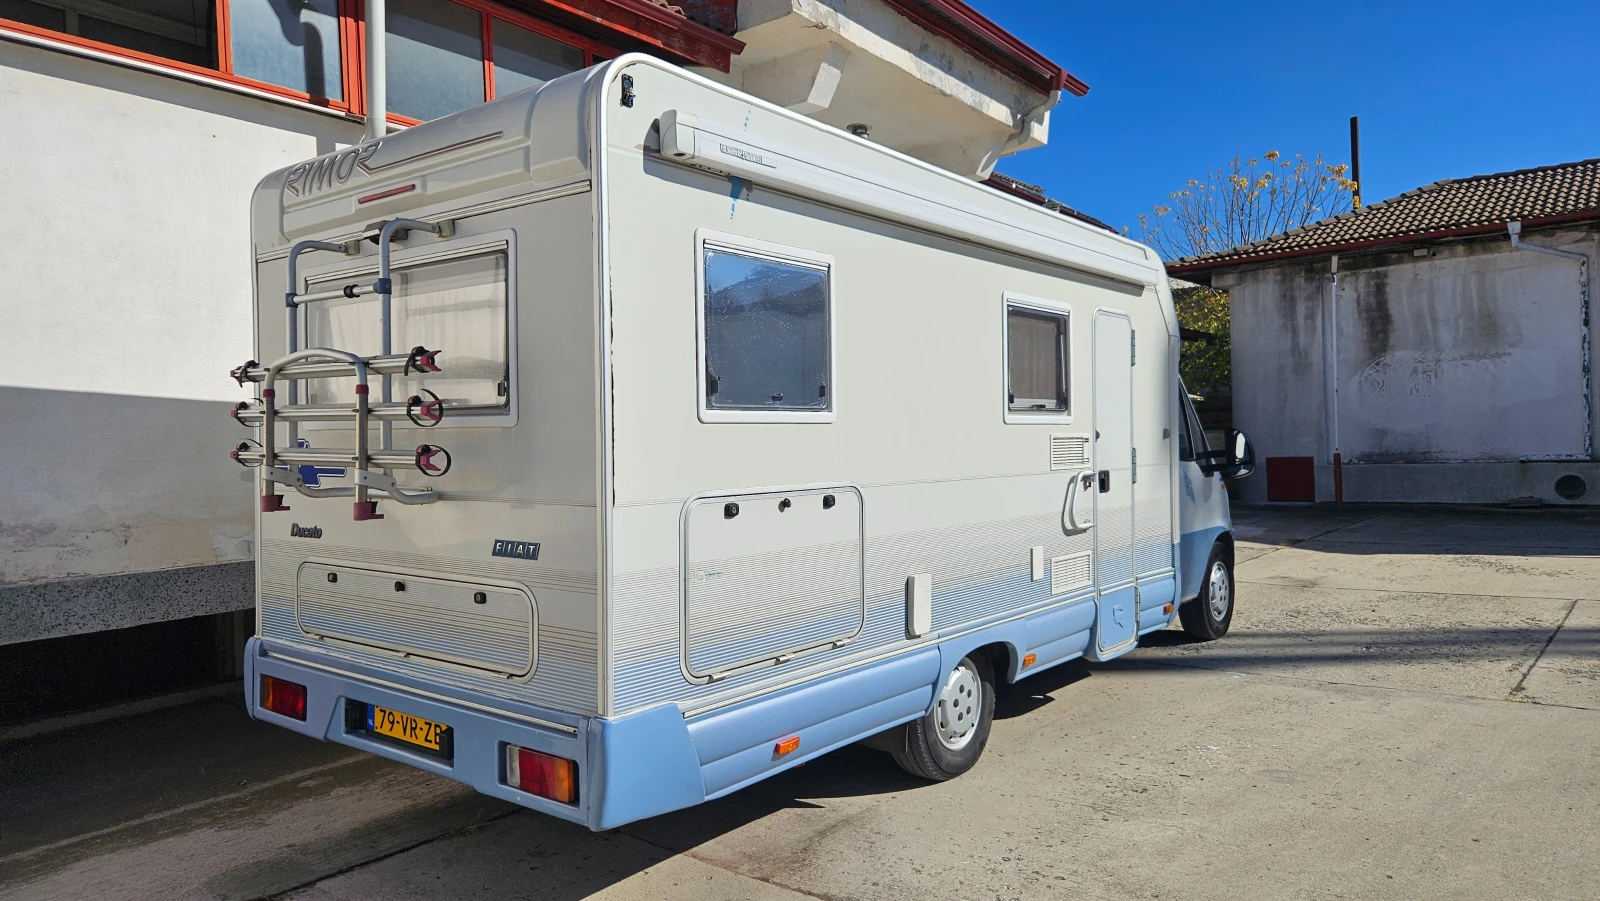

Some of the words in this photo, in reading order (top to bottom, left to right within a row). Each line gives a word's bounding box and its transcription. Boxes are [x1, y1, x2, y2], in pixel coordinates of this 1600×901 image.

[285, 141, 382, 198] RIMOR
[290, 522, 322, 539] Ducato
[495, 542, 536, 556] FIAT
[379, 708, 442, 746] 79-VR-ZB
